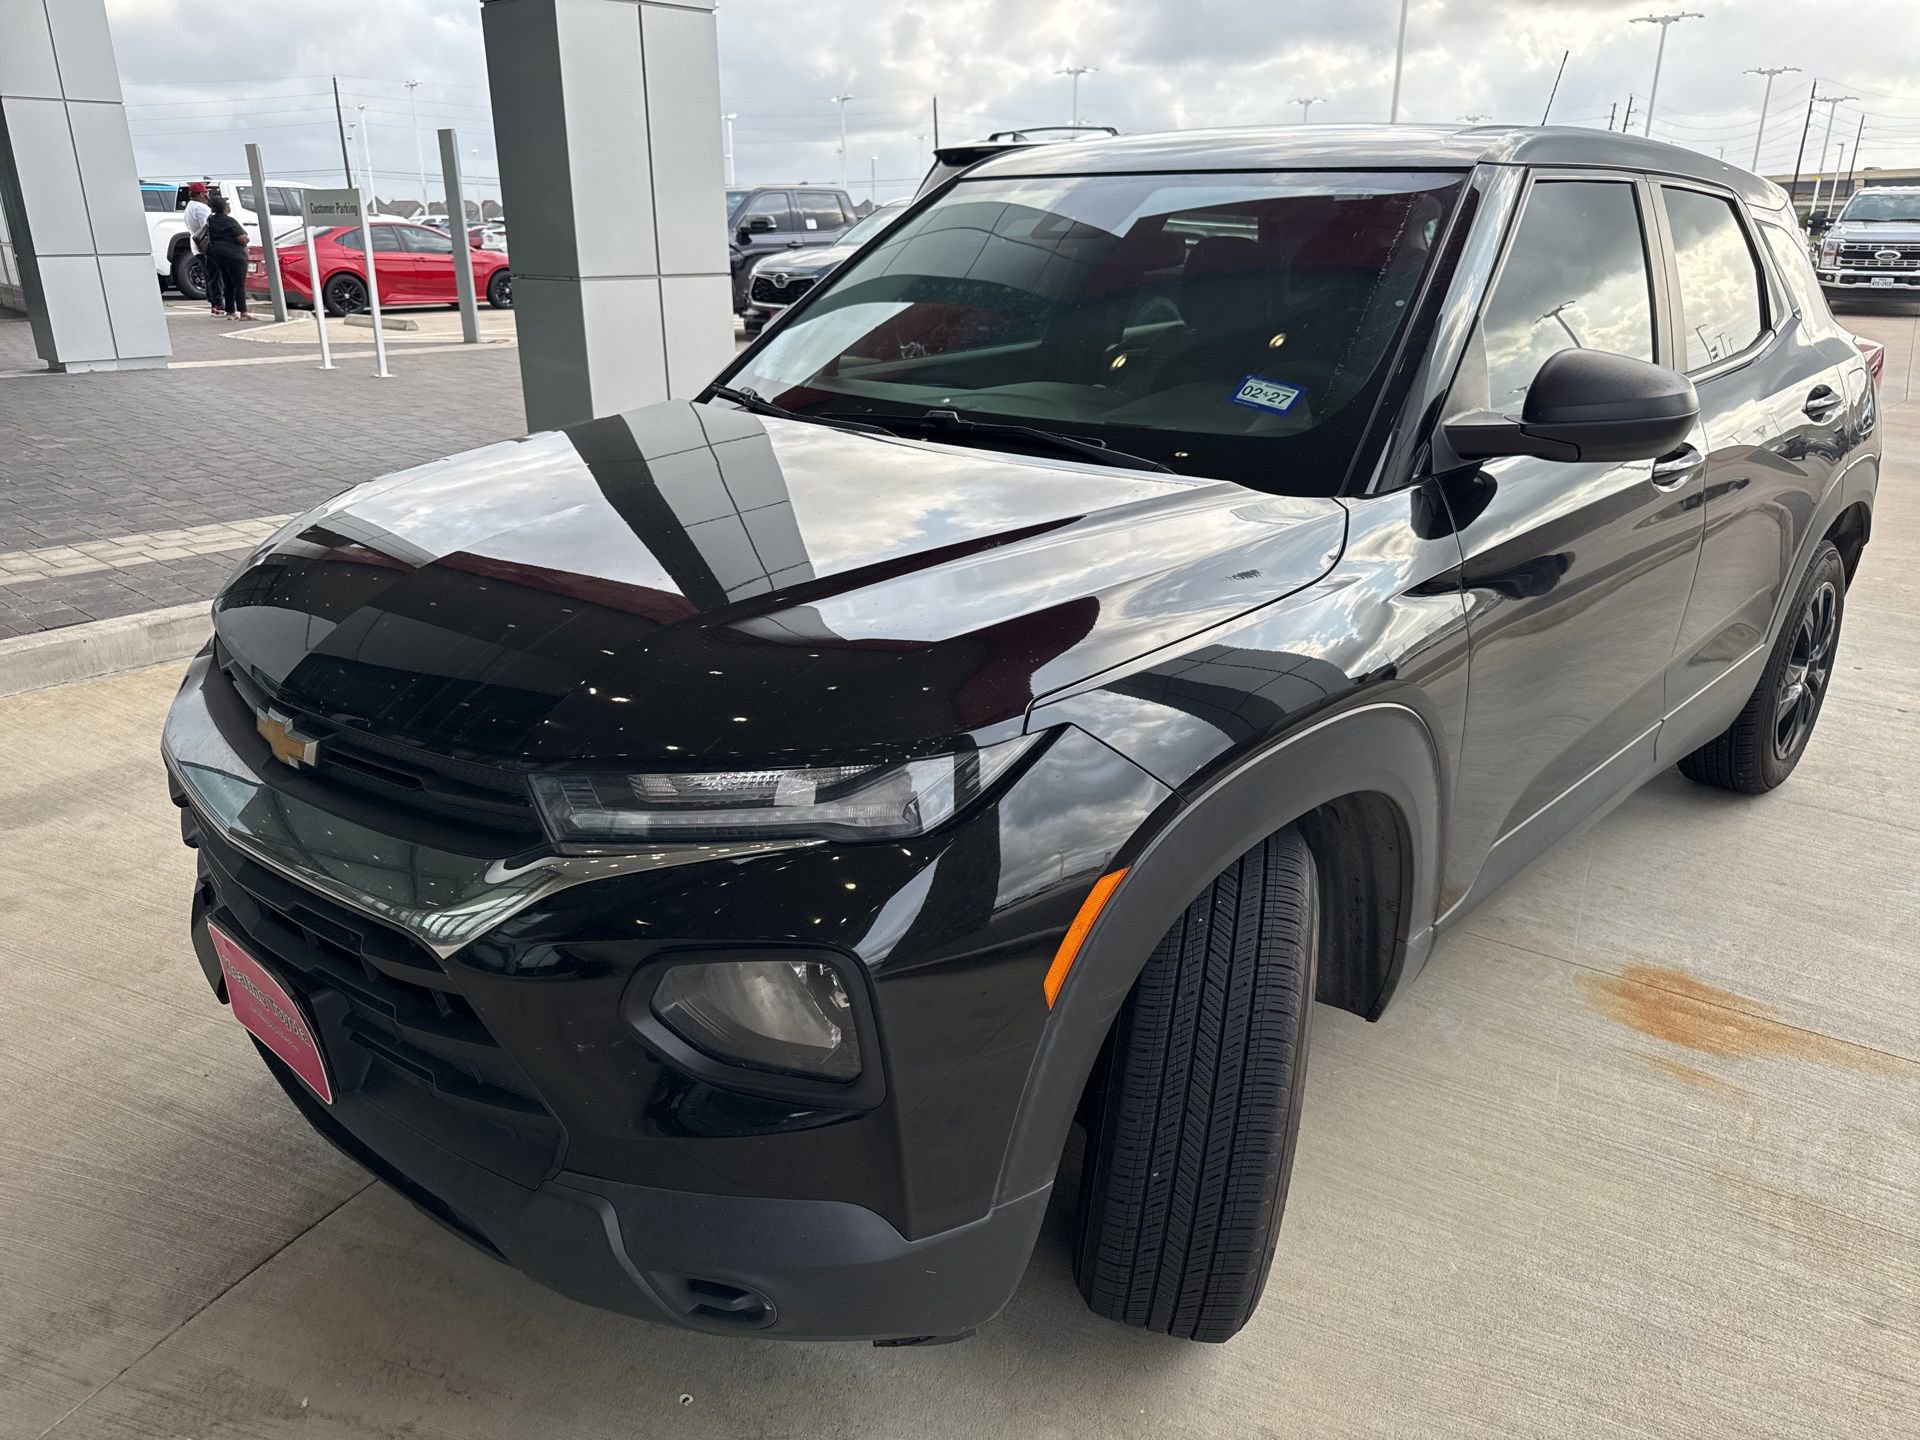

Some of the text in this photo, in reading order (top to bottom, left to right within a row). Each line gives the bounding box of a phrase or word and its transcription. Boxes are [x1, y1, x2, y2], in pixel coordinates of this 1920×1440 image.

[310, 202, 358, 216] Customer Parking
[1242, 385, 1263, 399] 02
[1266, 391, 1291, 404] 27
